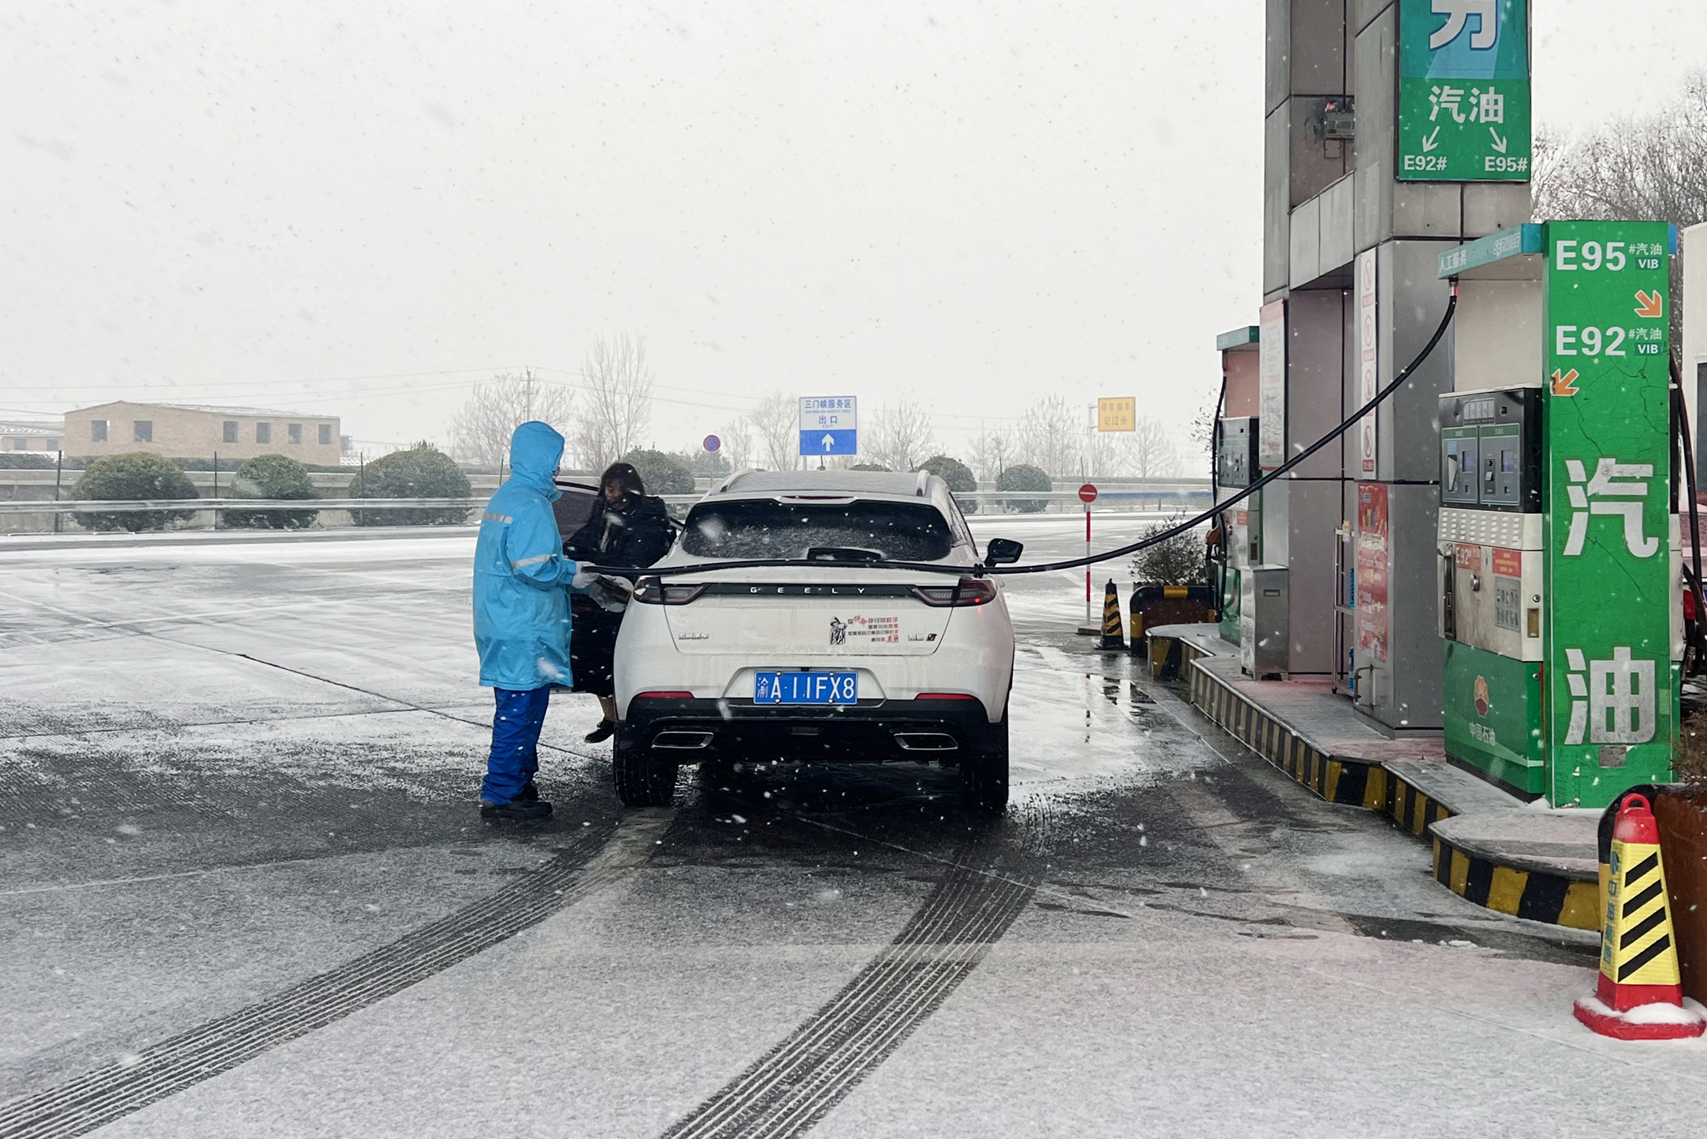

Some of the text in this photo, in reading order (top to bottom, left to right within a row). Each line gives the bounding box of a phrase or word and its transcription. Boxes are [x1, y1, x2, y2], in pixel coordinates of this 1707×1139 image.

[1428, 85, 1504, 124] 汽油
[1404, 155, 1528, 172] E92# E95#
[1556, 240, 1663, 271] E95 #汽油
[1638, 259, 1659, 269] VIB
[1555, 325, 1662, 356] E92 #汽油
[1637, 344, 1659, 354] VIB
[804, 399, 851, 409] 三门峡服务区
[818, 415, 838, 424] 出口
[1469, 721, 1496, 747] 中国石油
